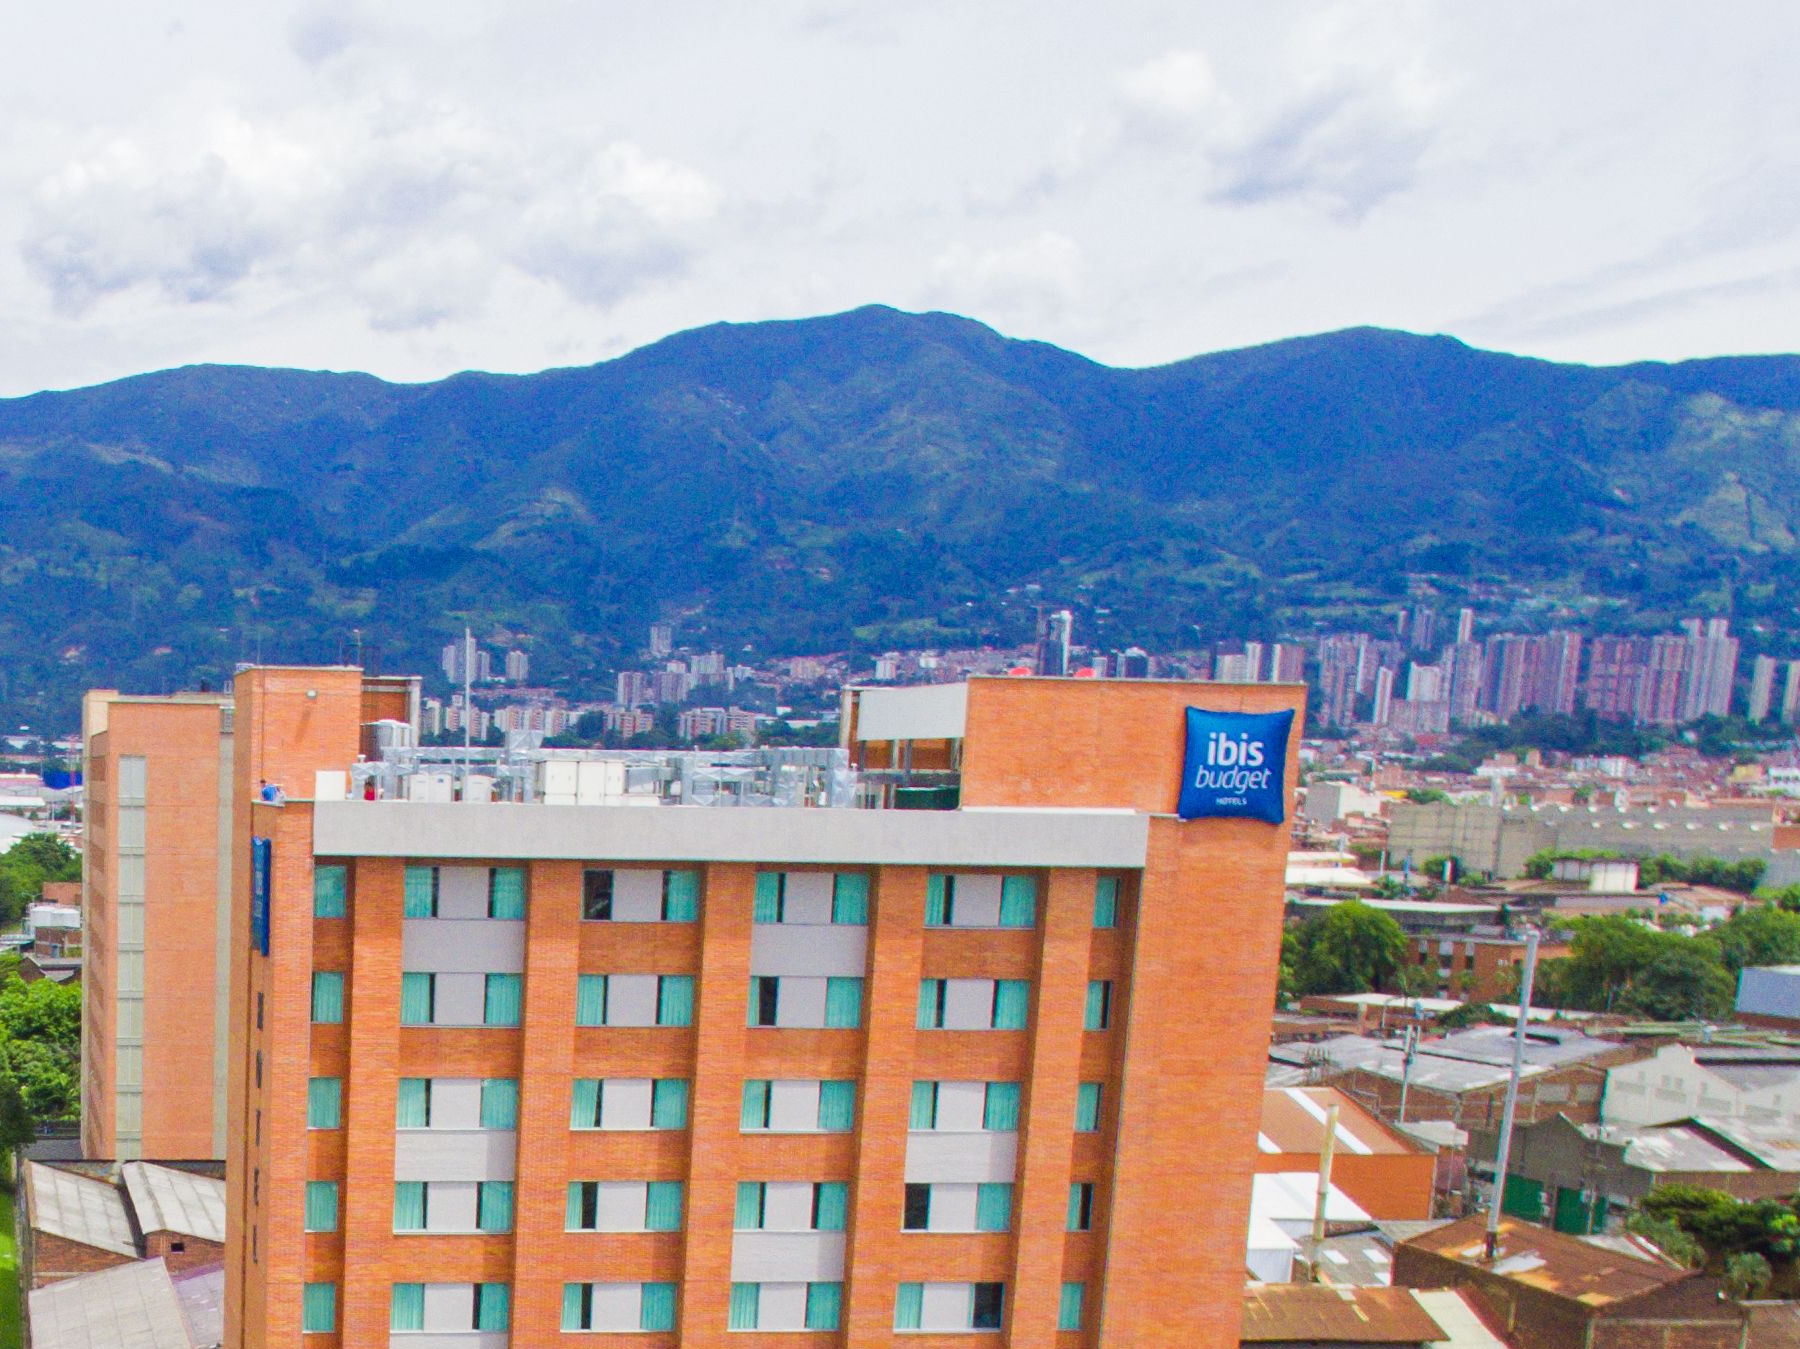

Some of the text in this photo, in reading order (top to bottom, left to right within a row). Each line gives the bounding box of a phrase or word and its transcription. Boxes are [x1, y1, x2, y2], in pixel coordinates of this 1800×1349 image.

[1207, 732, 1265, 766] ibis
[1195, 765, 1272, 794] budget
[1215, 797, 1247, 805] HOTELS
